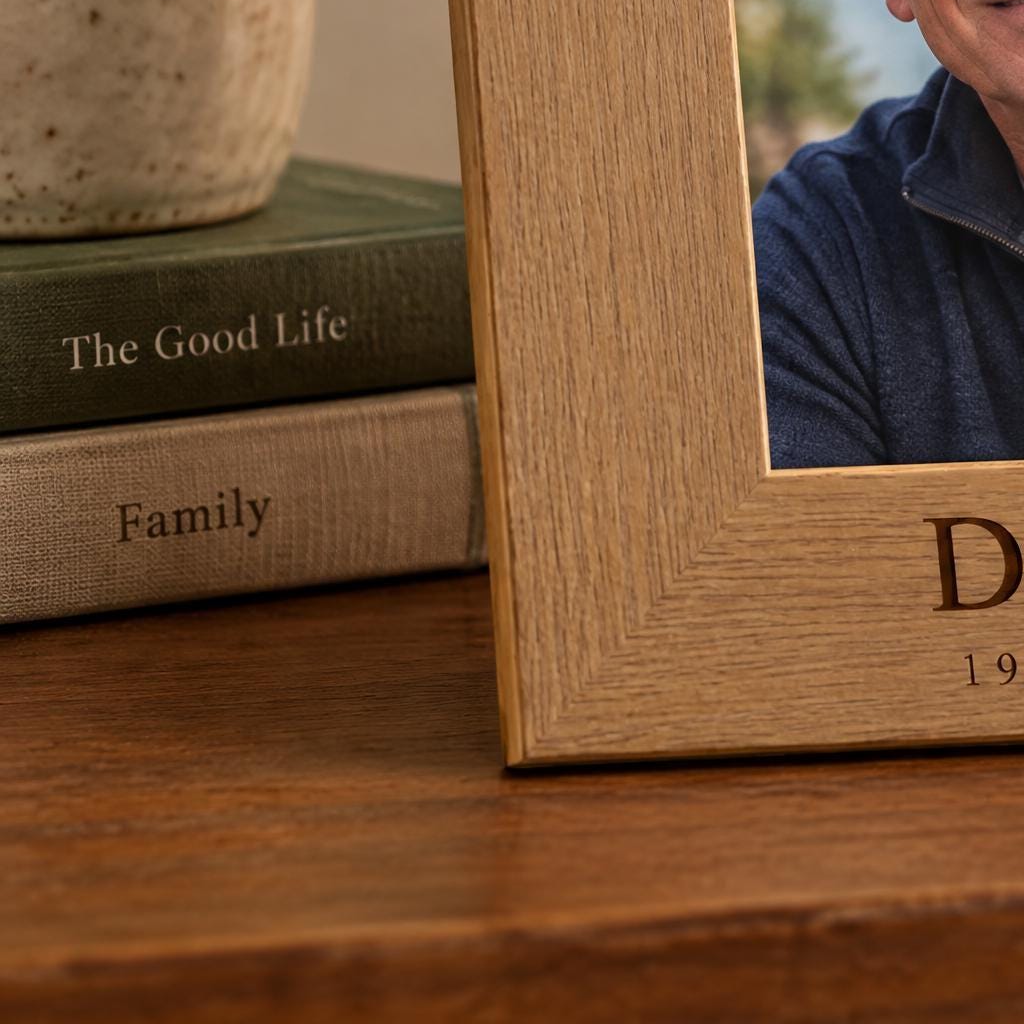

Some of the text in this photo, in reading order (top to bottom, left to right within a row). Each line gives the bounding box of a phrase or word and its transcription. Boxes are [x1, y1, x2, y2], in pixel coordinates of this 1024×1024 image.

[62, 305, 348, 371] The Good Life
[115, 486, 271, 543] Family
